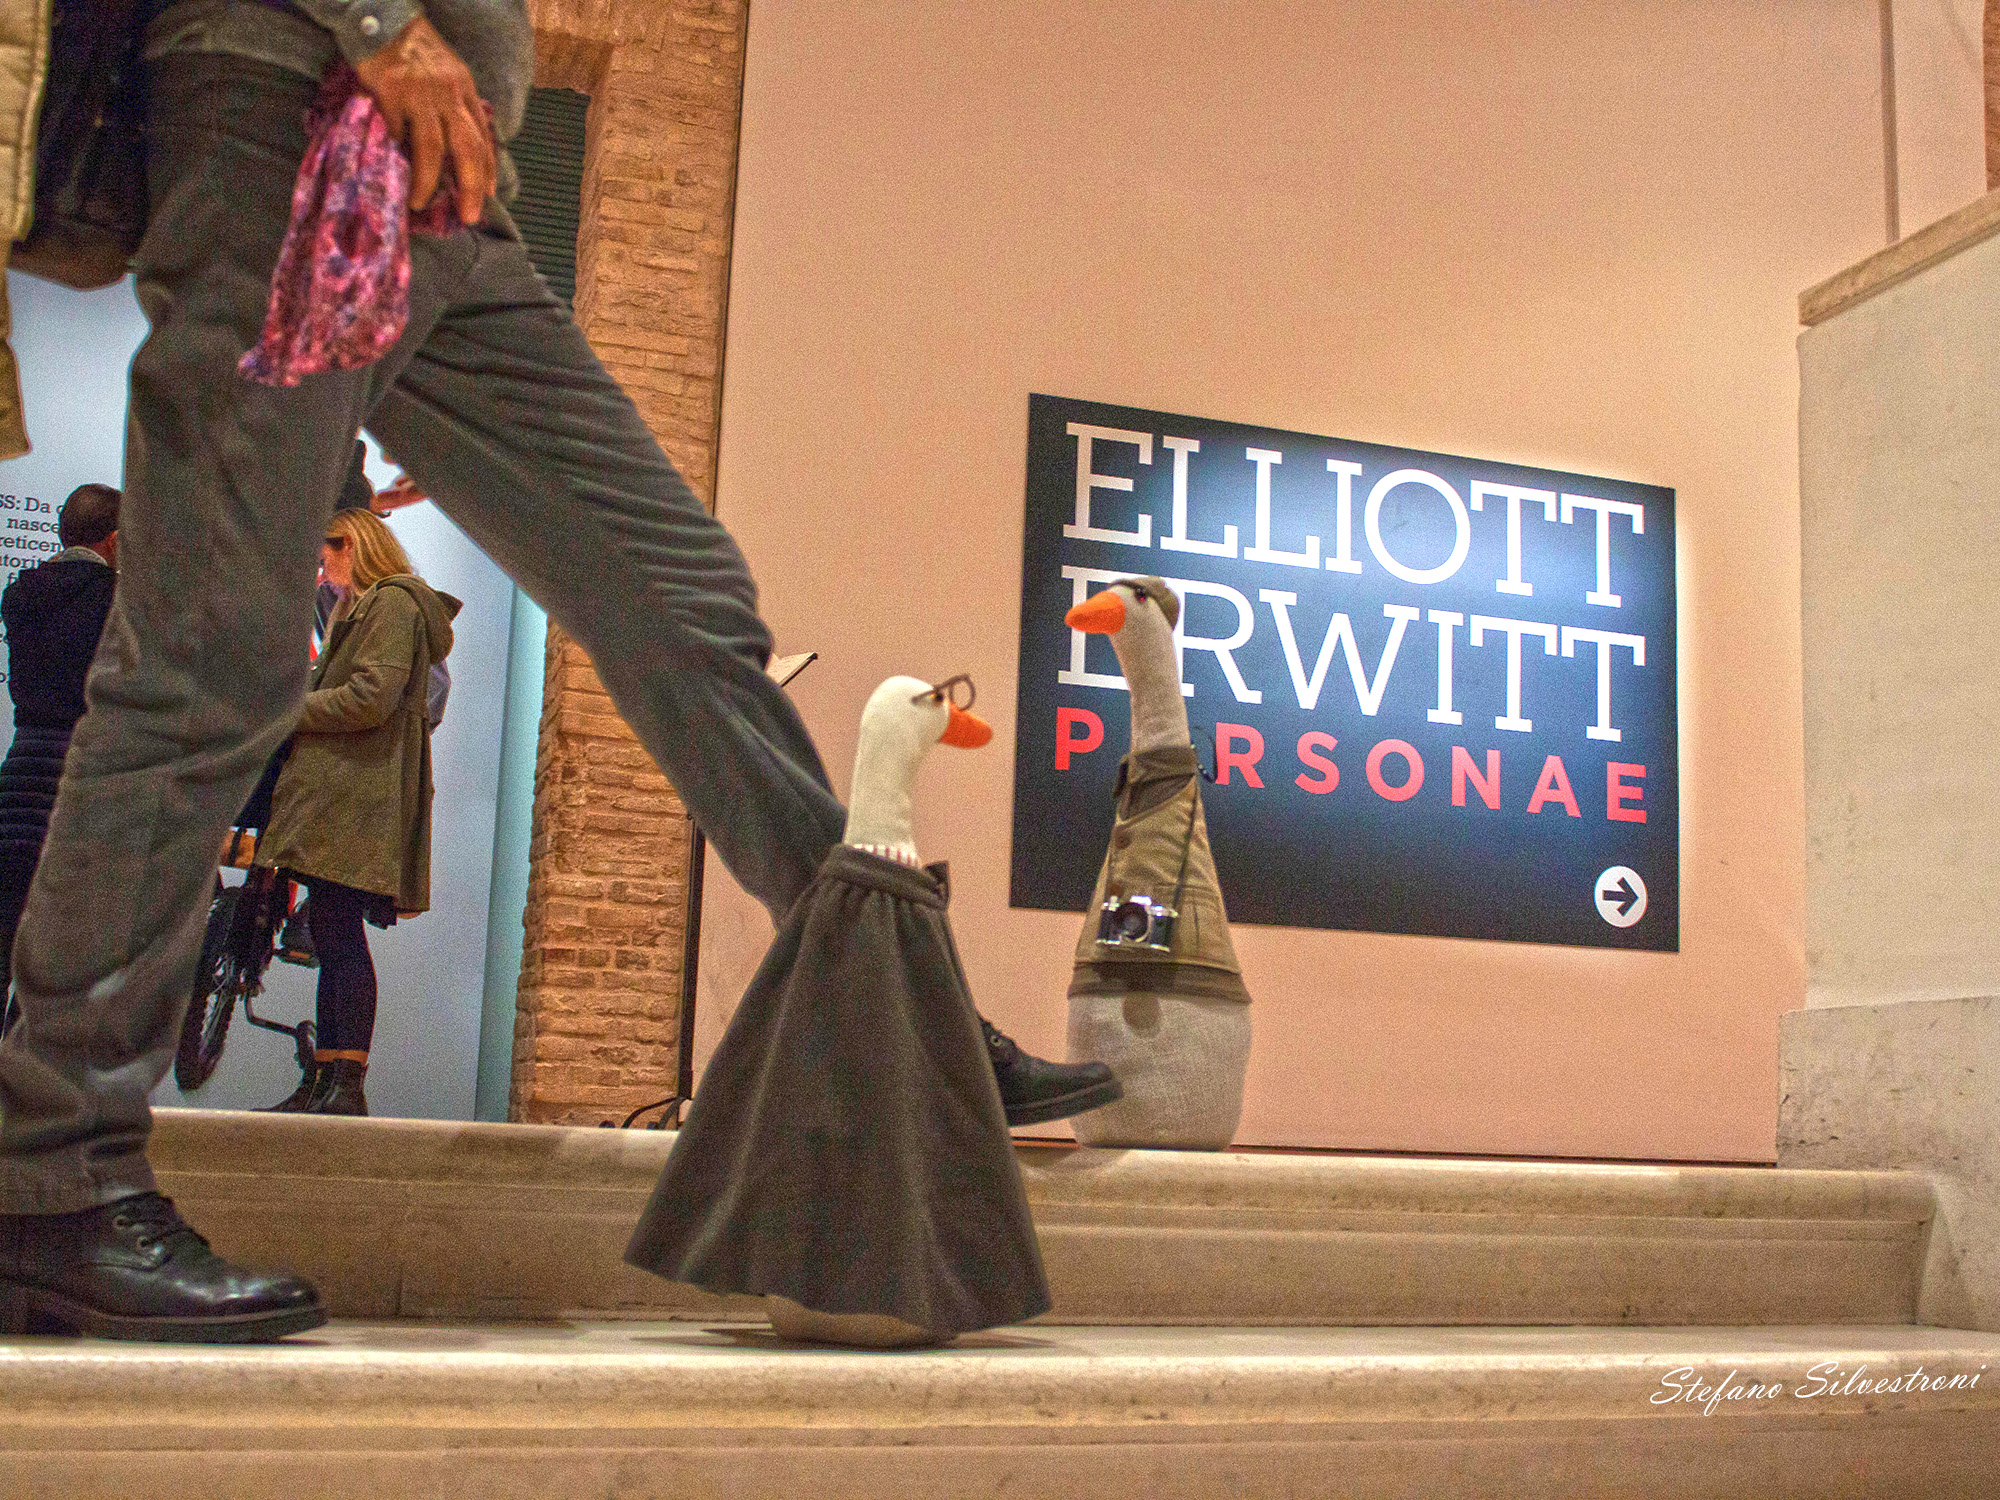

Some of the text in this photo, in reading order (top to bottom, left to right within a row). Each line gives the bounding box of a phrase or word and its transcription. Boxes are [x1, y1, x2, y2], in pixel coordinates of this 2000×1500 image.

[24, 497, 51, 514] Da
[1062, 421, 1645, 608] ELLIOTT
[1057, 564, 1647, 742] ERWITT
[1053, 705, 1647, 823] PRSONAE
